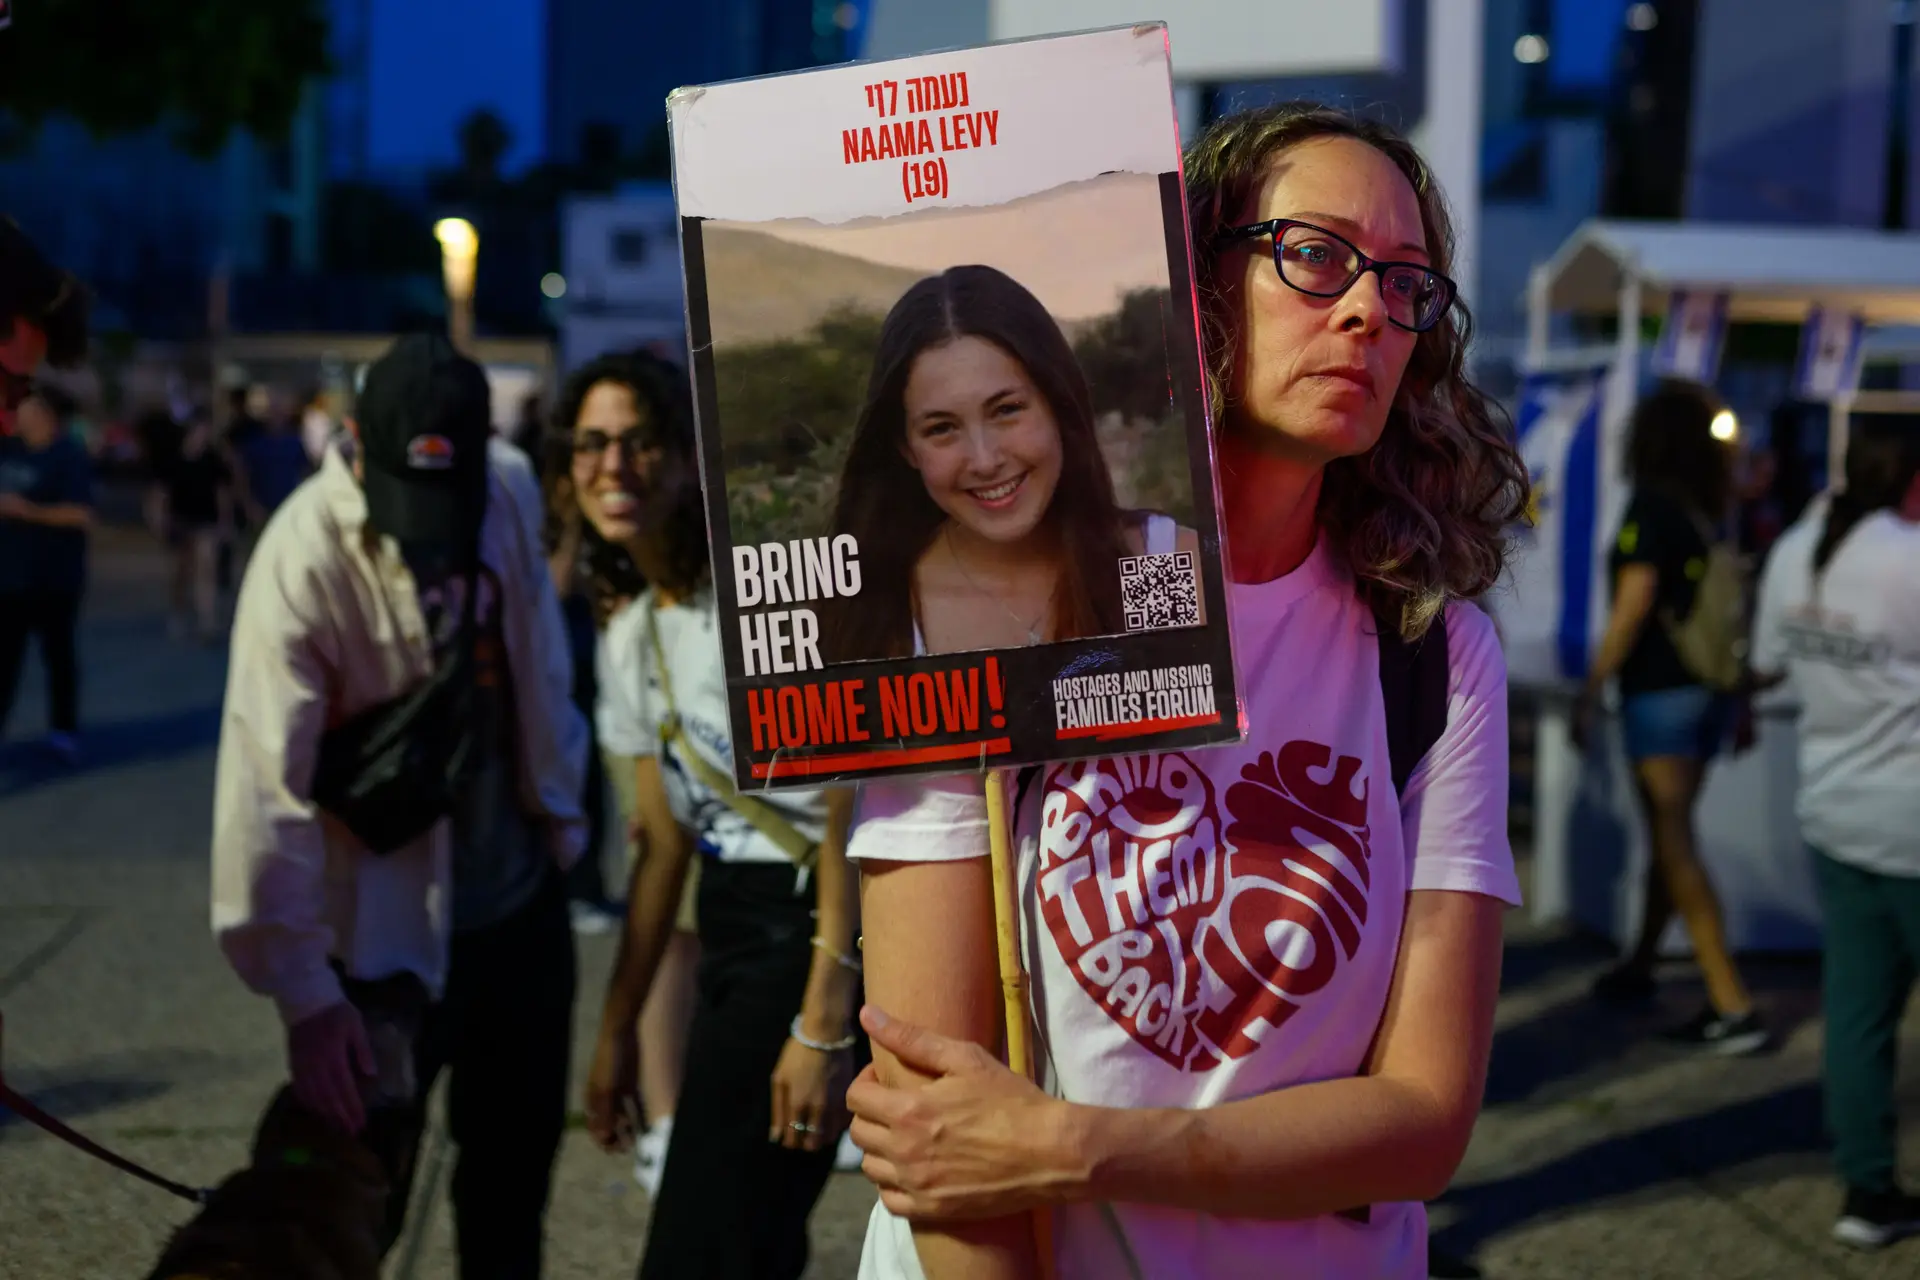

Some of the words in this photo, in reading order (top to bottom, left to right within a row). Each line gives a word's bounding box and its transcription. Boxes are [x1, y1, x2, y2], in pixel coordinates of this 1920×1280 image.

[864, 80, 898, 118] לוי
[905, 72, 969, 113] נעמה
[842, 119, 935, 165] NAAMA
[939, 110, 999, 152] LEVY
[902, 157, 948, 203] (19)
[732, 534, 862, 608] BRING
[739, 609, 824, 677] HER
[747, 678, 870, 752] HOME
[878, 656, 1006, 739] NOW!
[1053, 672, 1121, 701] HOSTAGES
[1124, 669, 1151, 693] AND
[1152, 664, 1213, 691] MISSING
[1055, 692, 1141, 730] FAMILIES
[1146, 685, 1217, 721] FORUM
[1041, 817, 1217, 947] THEM
